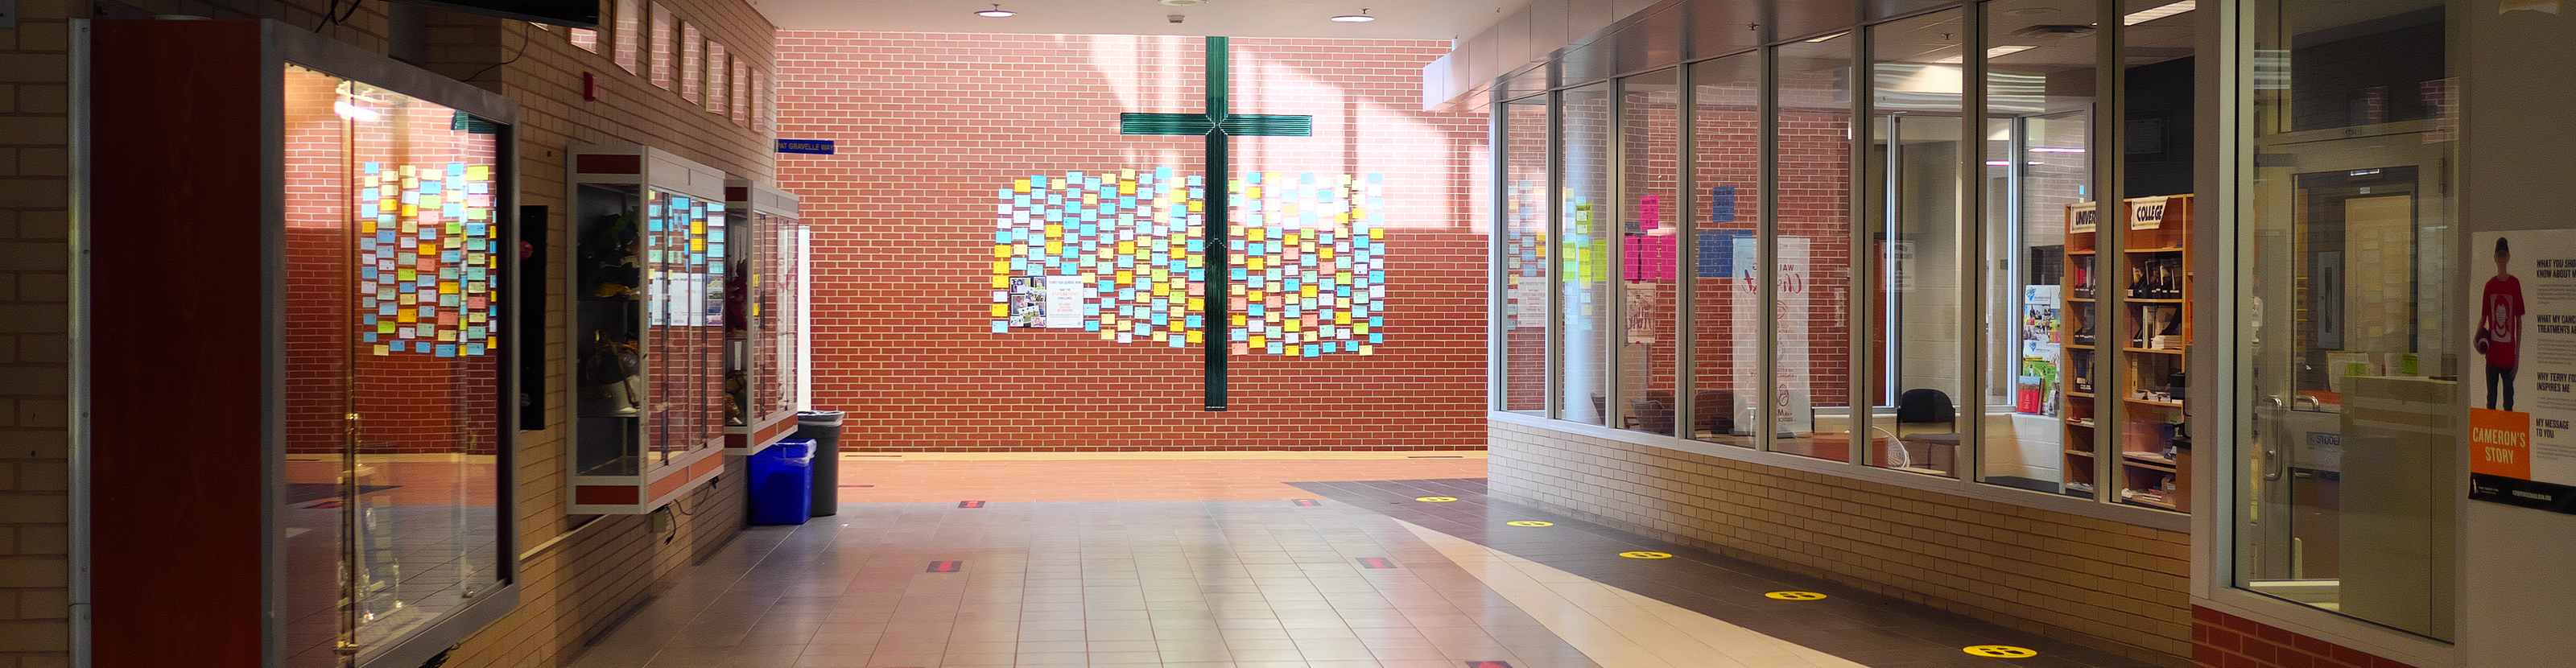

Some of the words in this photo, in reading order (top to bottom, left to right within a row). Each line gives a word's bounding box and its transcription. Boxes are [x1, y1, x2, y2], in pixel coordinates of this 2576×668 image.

[789, 142, 819, 151] GRAVELLE
[2136, 205, 2163, 222] COLLEGE
[2537, 259, 2551, 267] WHAT
[2553, 259, 2564, 267] YOU
[2537, 270, 2552, 278] KNOW
[2553, 270, 2570, 278] ABOUT
[2537, 314, 2551, 323] WHAT
[2552, 315, 2561, 324] MY
[2537, 324, 2570, 334] TREATMENTS
[2537, 372, 2549, 381] WHY
[2550, 373, 2568, 382] TERRY
[2537, 382, 2561, 392] INSPIRES
[2562, 384, 2570, 393] ME
[2536, 418, 2544, 427] MY
[2545, 419, 2569, 429] MESSAGE
[2472, 427, 2526, 447] CAMERON'S
[2536, 428, 2543, 437] TO
[2544, 429, 2554, 438] YOU
[2484, 447, 2514, 464] STORY
